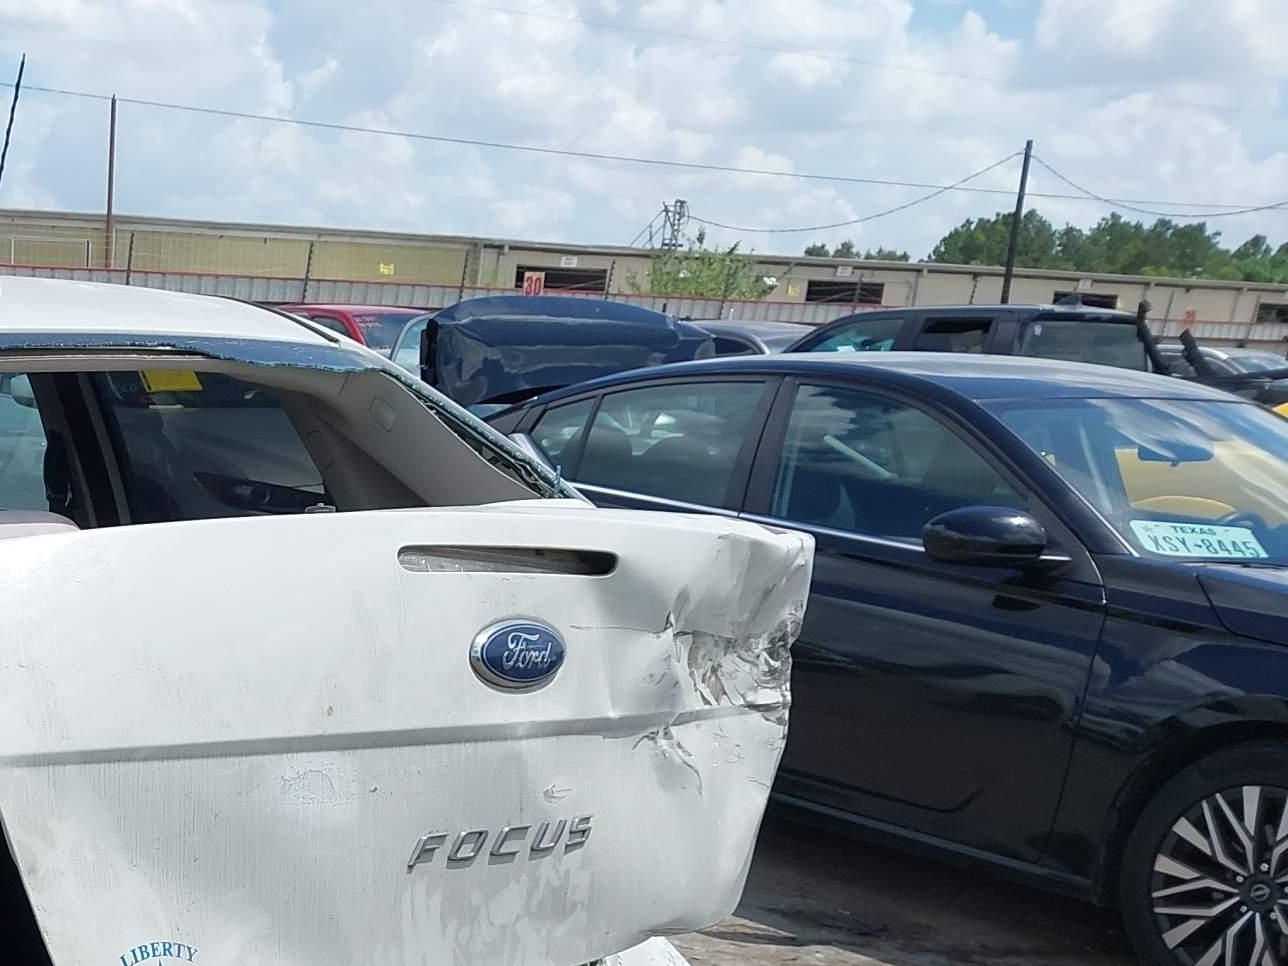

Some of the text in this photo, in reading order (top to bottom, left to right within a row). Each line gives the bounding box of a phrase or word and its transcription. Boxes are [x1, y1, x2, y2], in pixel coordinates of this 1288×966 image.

[525, 276, 542, 296] 30
[1169, 525, 1217, 536] TEXAS
[503, 631, 553, 671] Ford
[407, 814, 594, 874] FOCUS
